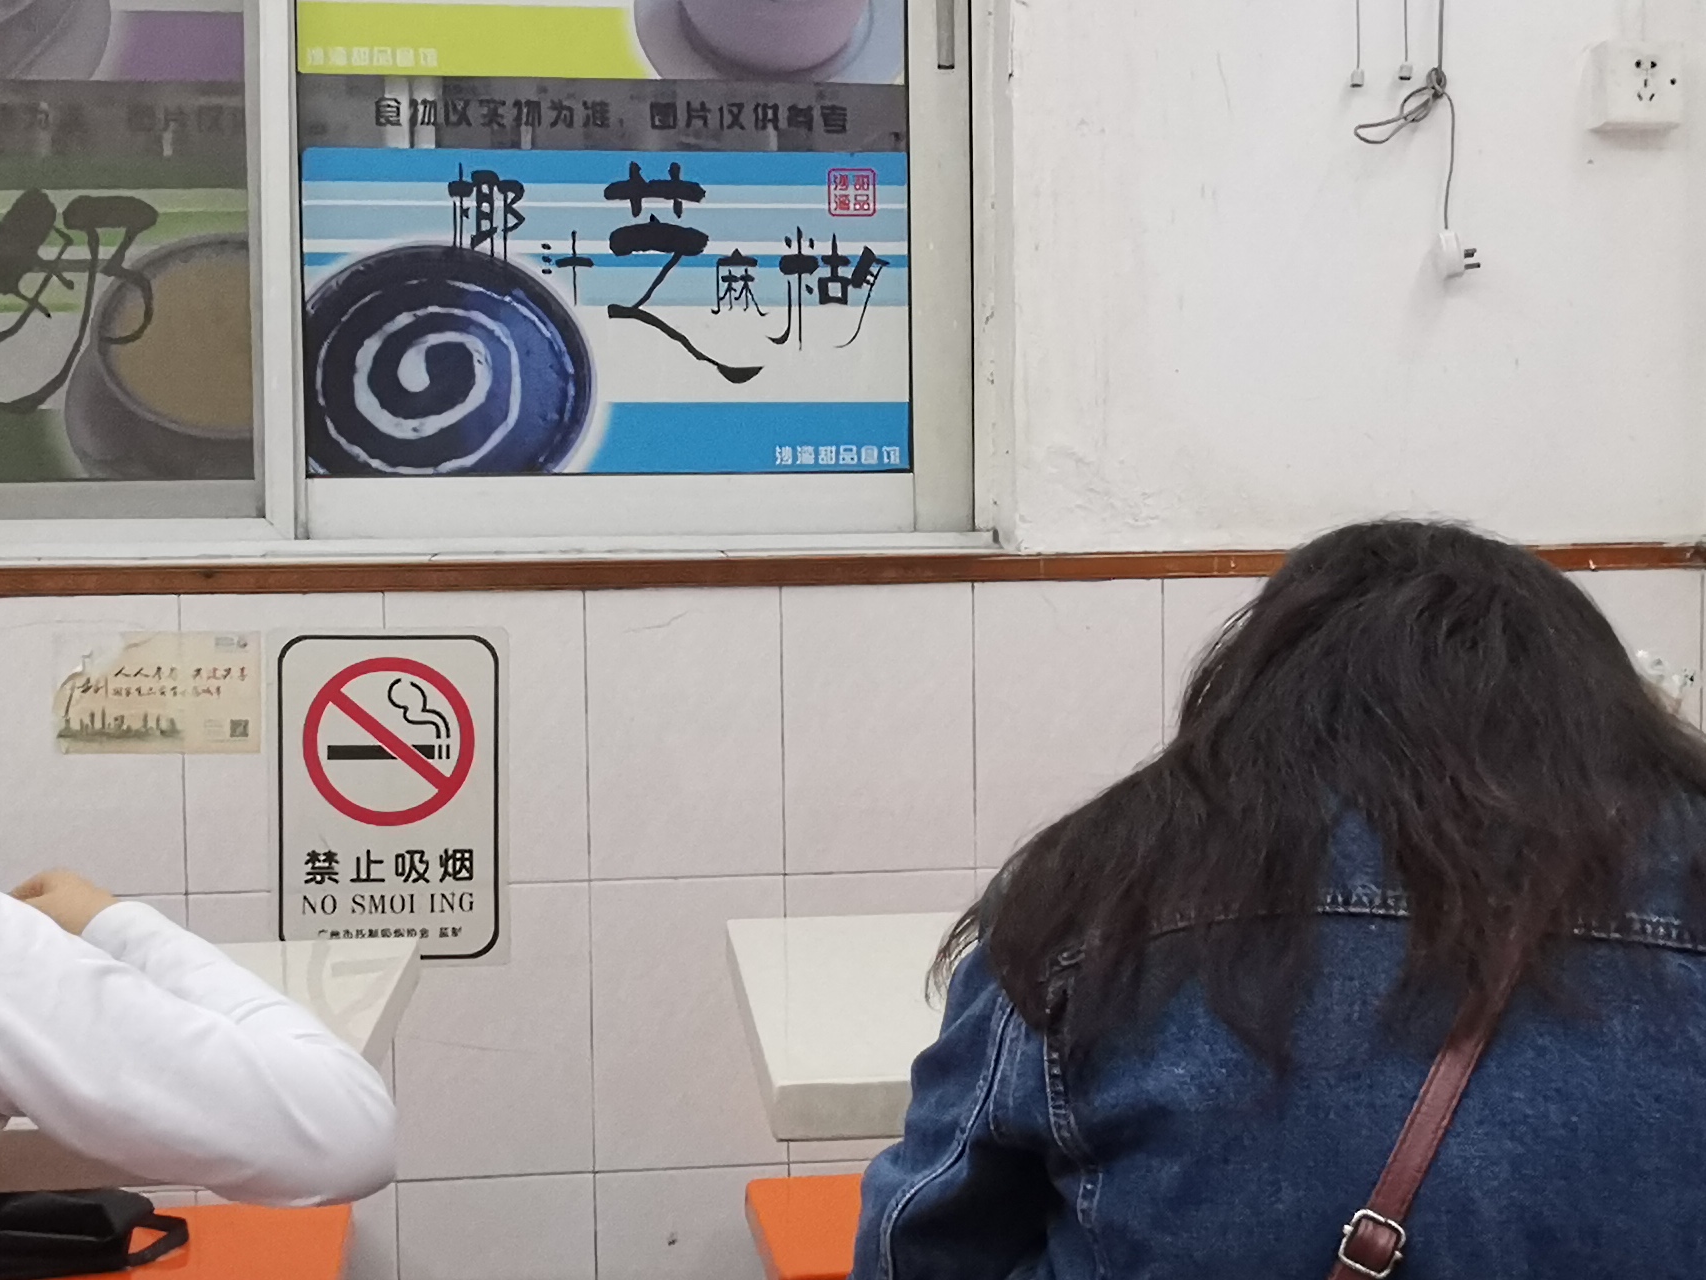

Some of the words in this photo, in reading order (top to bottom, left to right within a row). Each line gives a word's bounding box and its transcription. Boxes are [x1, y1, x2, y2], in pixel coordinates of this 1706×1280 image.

[304, 847, 474, 884] 禁止吸烟
[302, 893, 337, 915] NO
